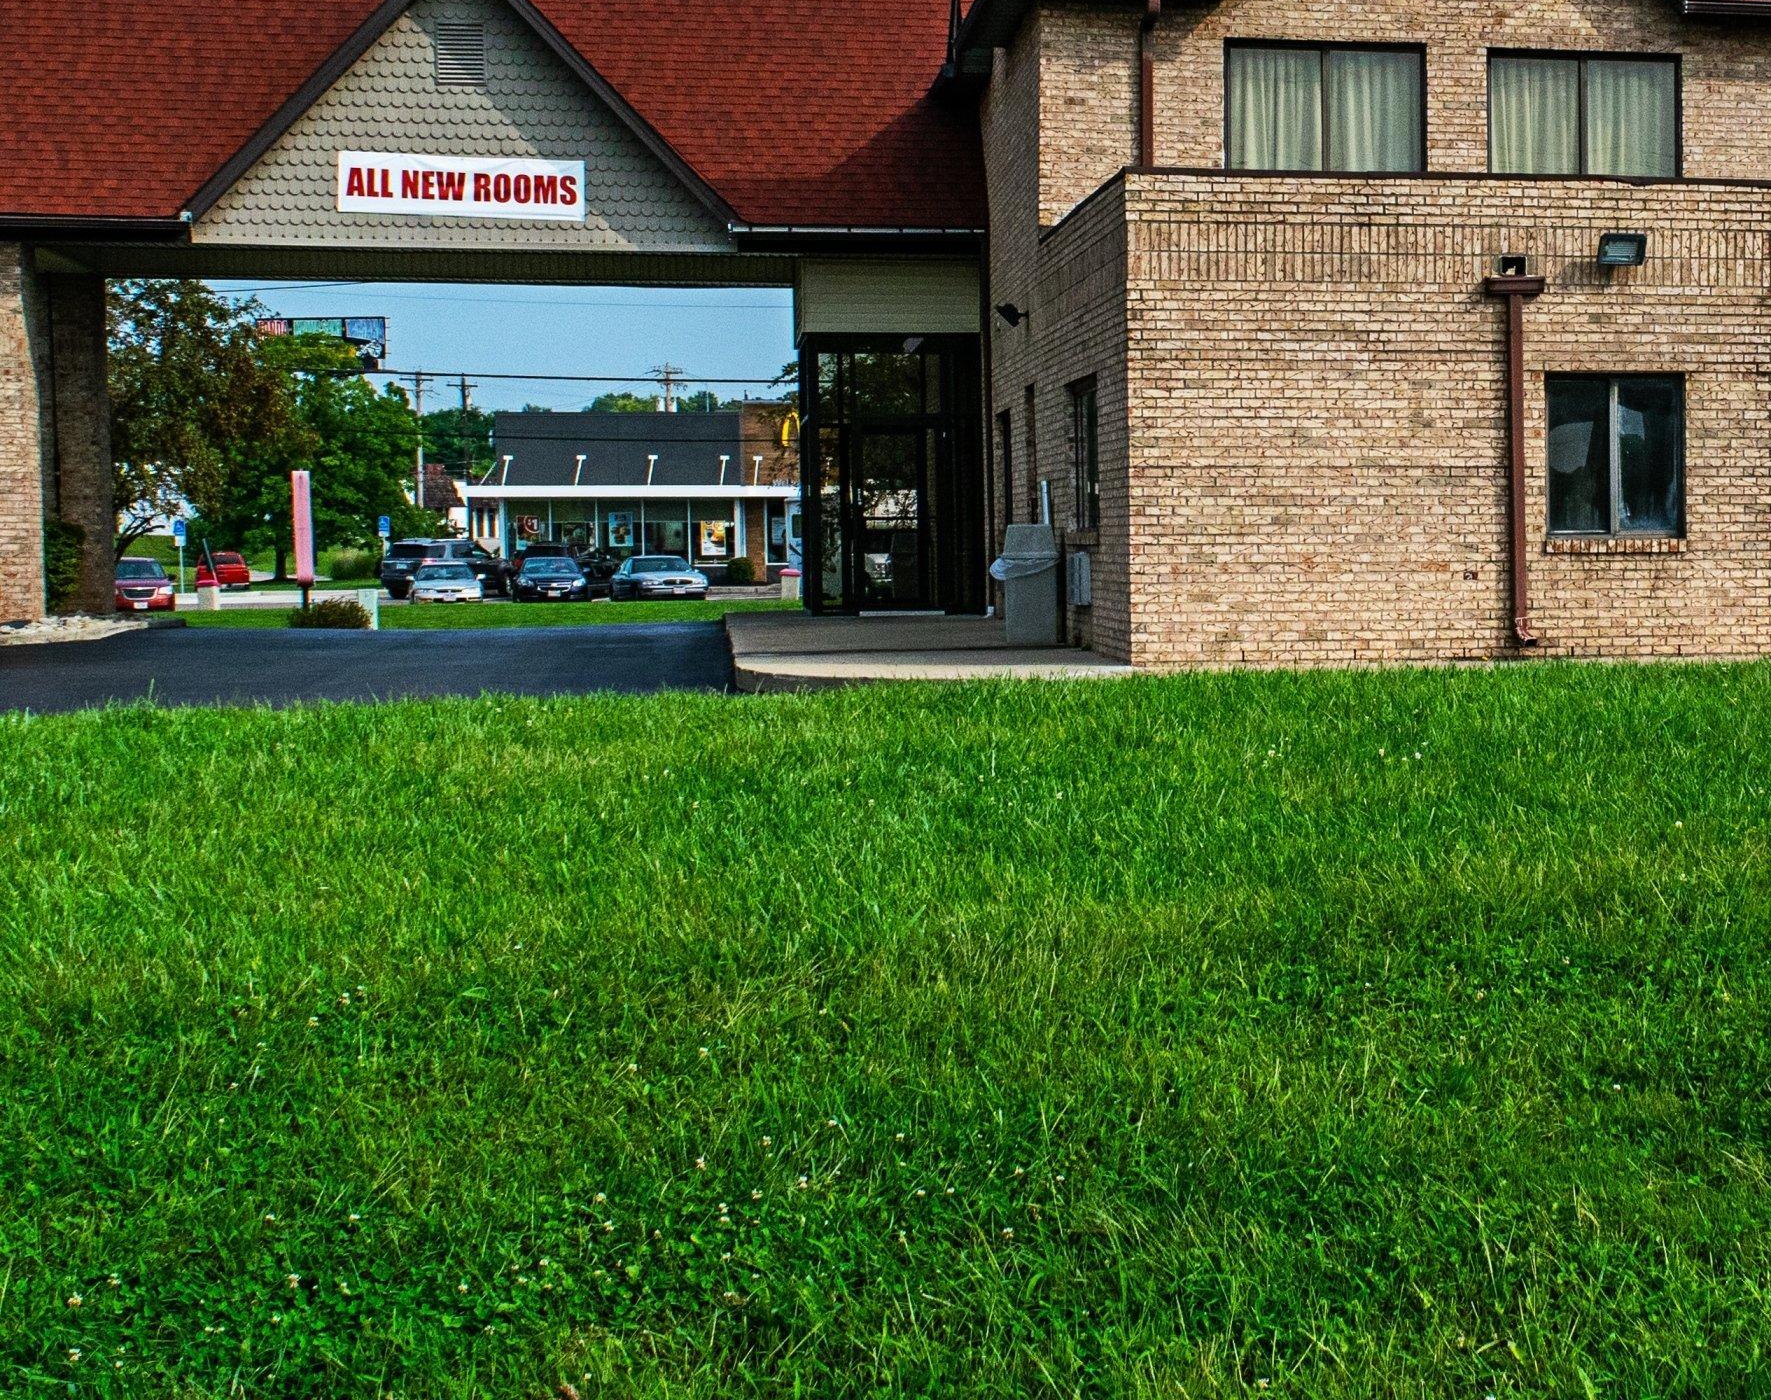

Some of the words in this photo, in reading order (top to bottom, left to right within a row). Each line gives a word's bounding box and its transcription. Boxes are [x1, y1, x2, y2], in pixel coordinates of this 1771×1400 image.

[346, 167, 393, 198] ALL
[401, 170, 466, 201] NEW
[473, 173, 577, 205] ROOMS
